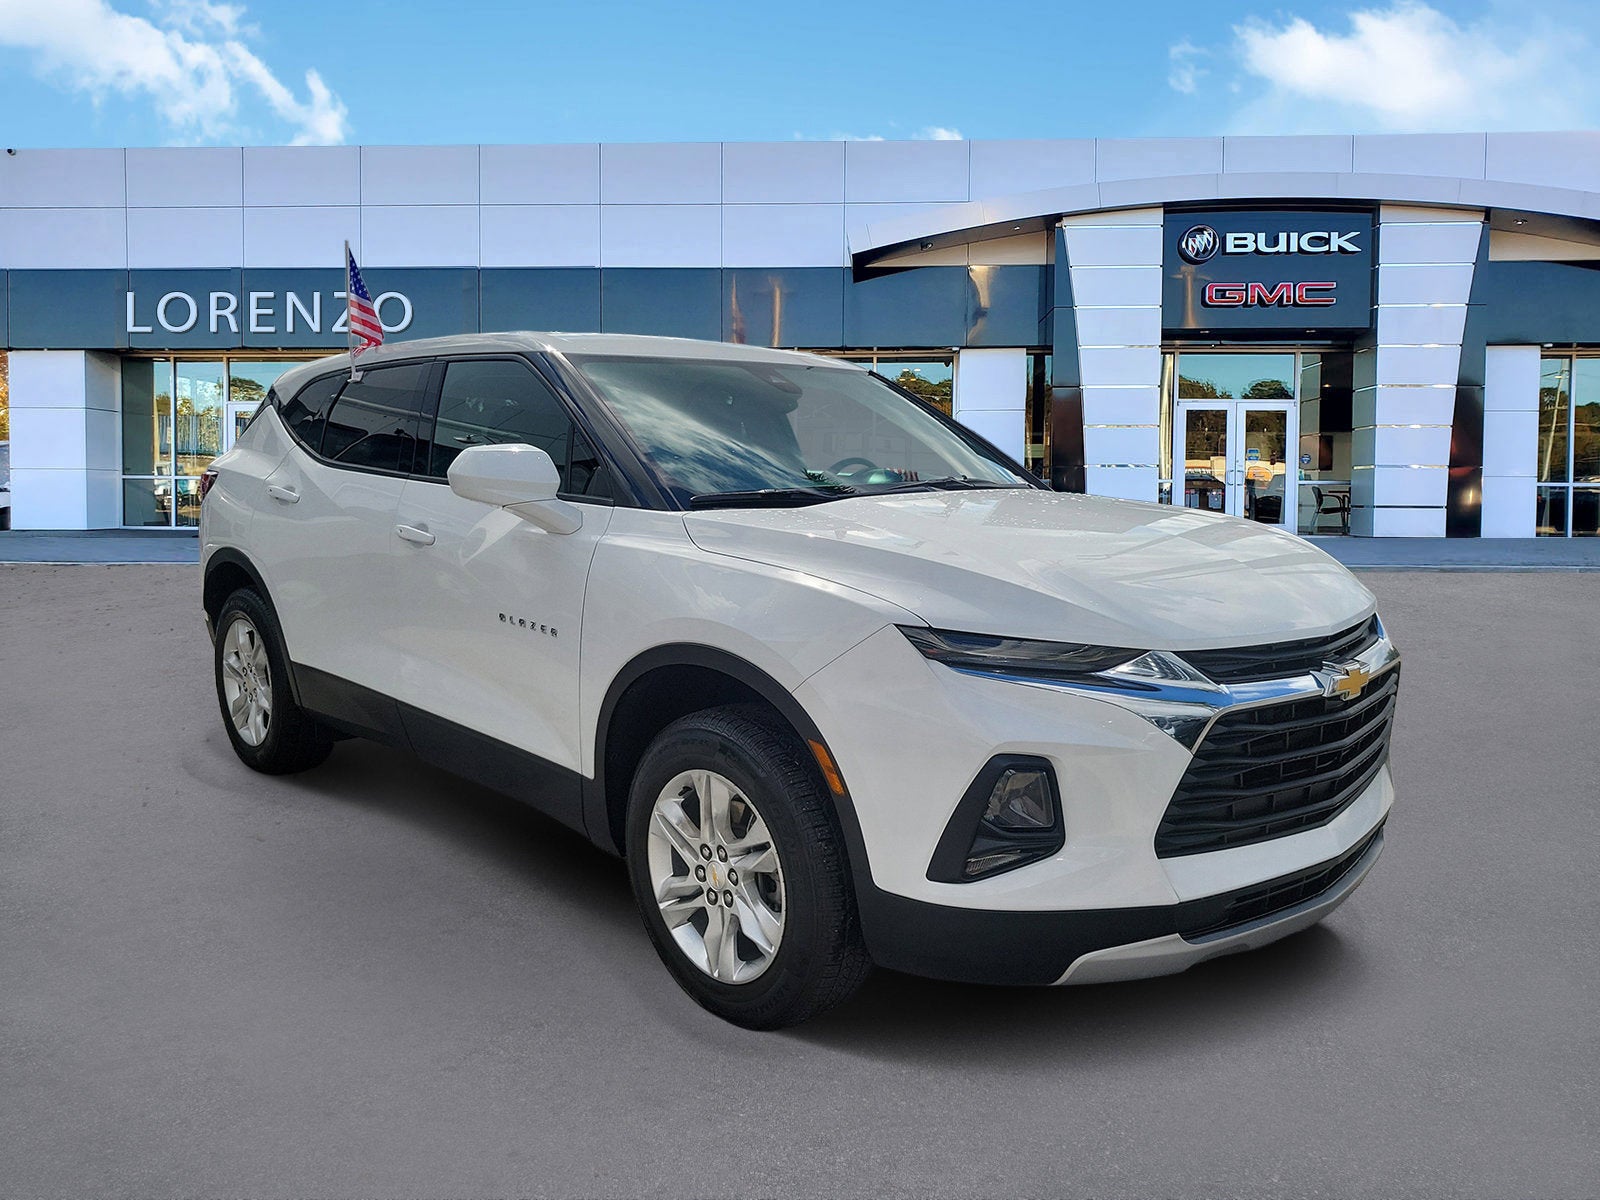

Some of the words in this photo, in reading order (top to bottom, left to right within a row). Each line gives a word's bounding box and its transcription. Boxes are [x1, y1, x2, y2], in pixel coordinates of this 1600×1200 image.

[1225, 231, 1362, 252] BUICK
[1205, 282, 1337, 305] GMC
[498, 612, 559, 638] BLAZER
